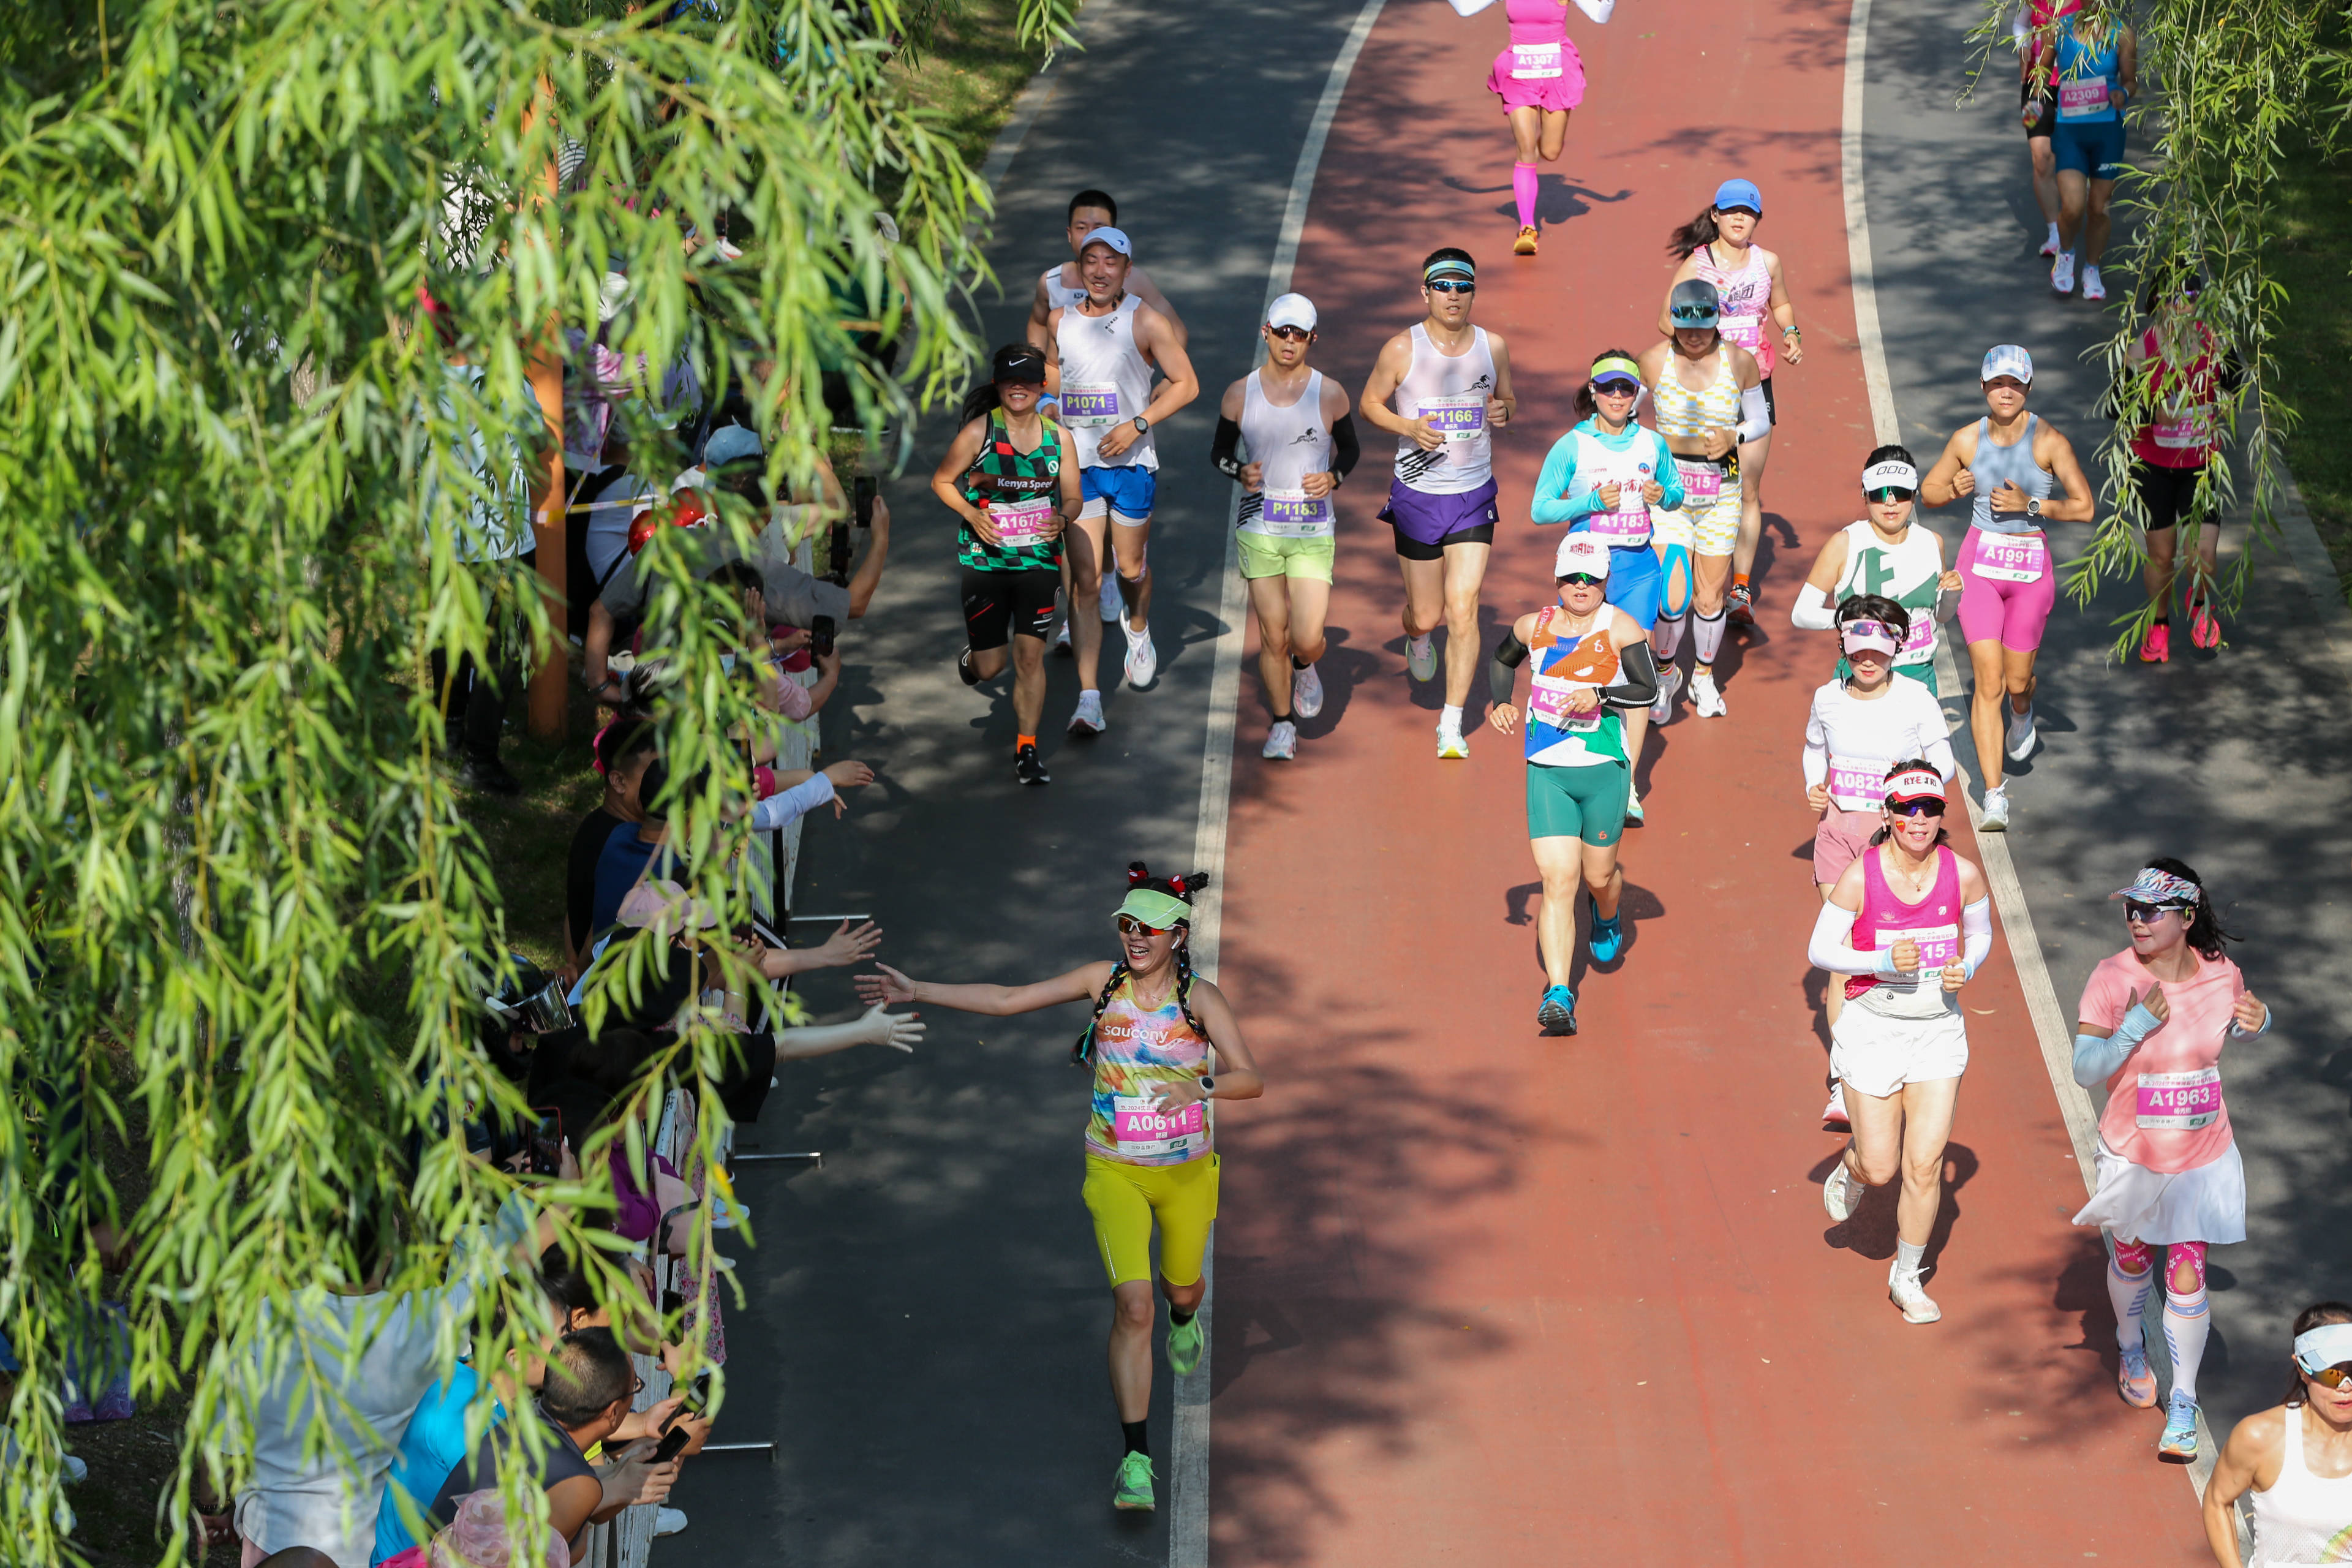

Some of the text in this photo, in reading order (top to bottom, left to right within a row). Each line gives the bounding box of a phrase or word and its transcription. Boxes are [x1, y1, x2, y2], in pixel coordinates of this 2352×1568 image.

[1518, 54, 1553, 65] A1307
[2065, 88, 2099, 102] A2309
[1067, 396, 1106, 409] P1071
[997, 478, 1028, 489] Kenya
[999, 513, 1043, 529] A1673
[1599, 514, 1644, 528] A1183
[1985, 546, 2032, 564] A1991
[1834, 772, 1885, 792] A0823
[1904, 777, 1921, 785] RYE
[1104, 1025, 1169, 1043] saucony
[2149, 1087, 2210, 1106] A1963
[1127, 1110, 1187, 1131] A0611
